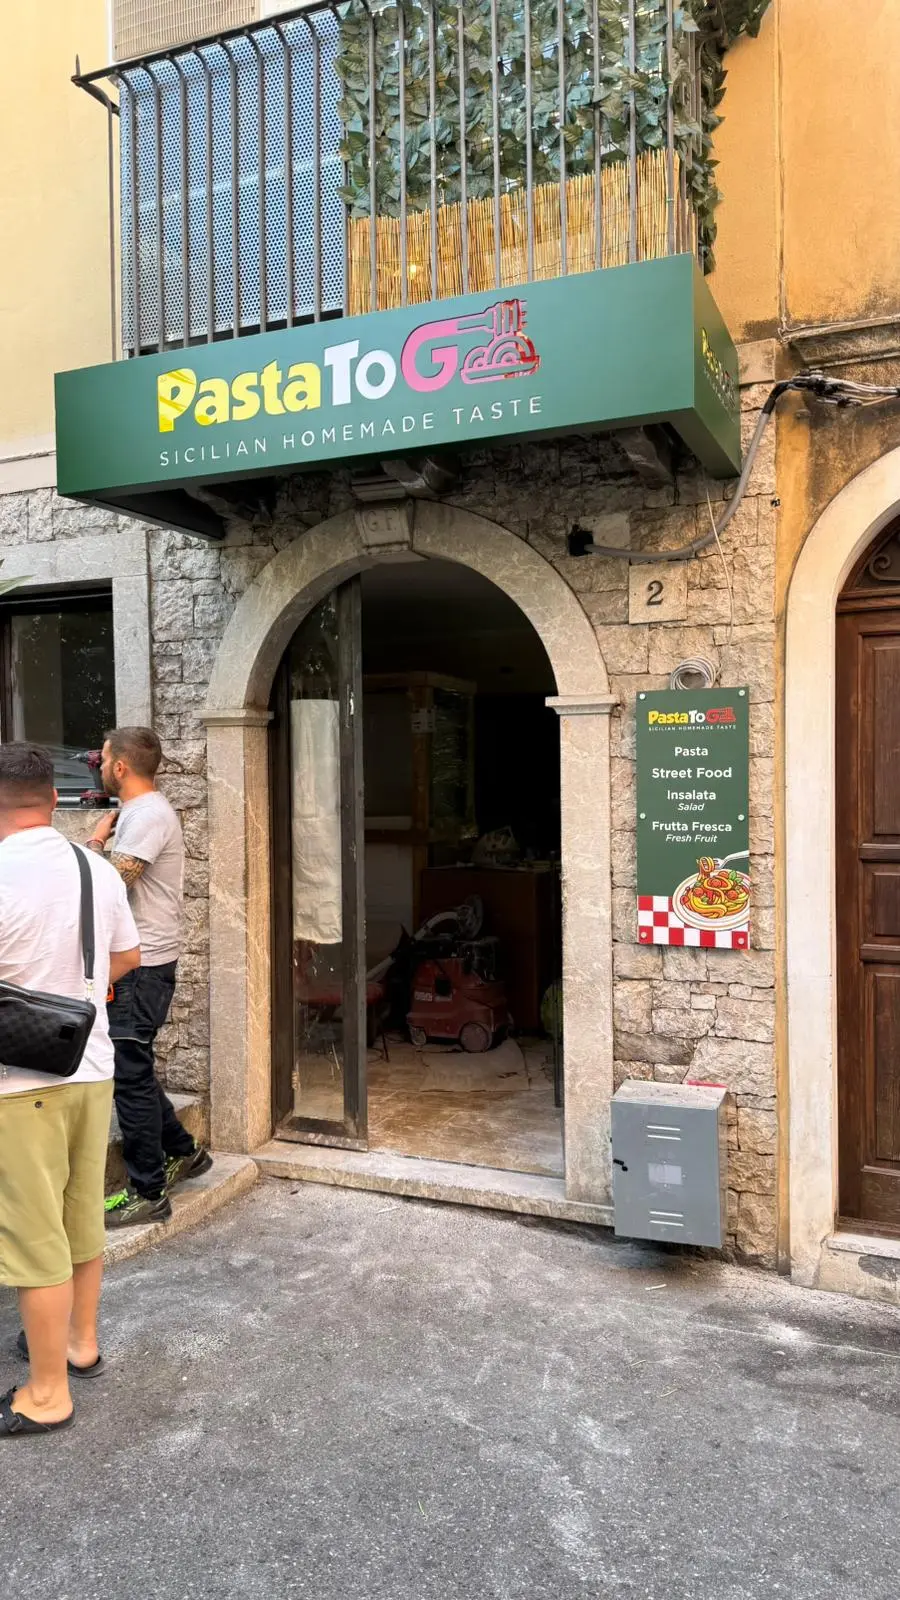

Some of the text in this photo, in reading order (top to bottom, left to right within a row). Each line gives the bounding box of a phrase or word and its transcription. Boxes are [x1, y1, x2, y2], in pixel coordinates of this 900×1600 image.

[160, 396, 542, 466] SICILIAN HOMEMADE TASTE
[646, 580, 664, 606] 2
[674, 746, 709, 757] Pasta
[651, 767, 732, 779] Street Food
[667, 789, 717, 800] Insalata
[677, 803, 705, 811] Salad
[652, 821, 732, 832] Frutta Fresca
[665, 834, 718, 842] Fresh Fruit
